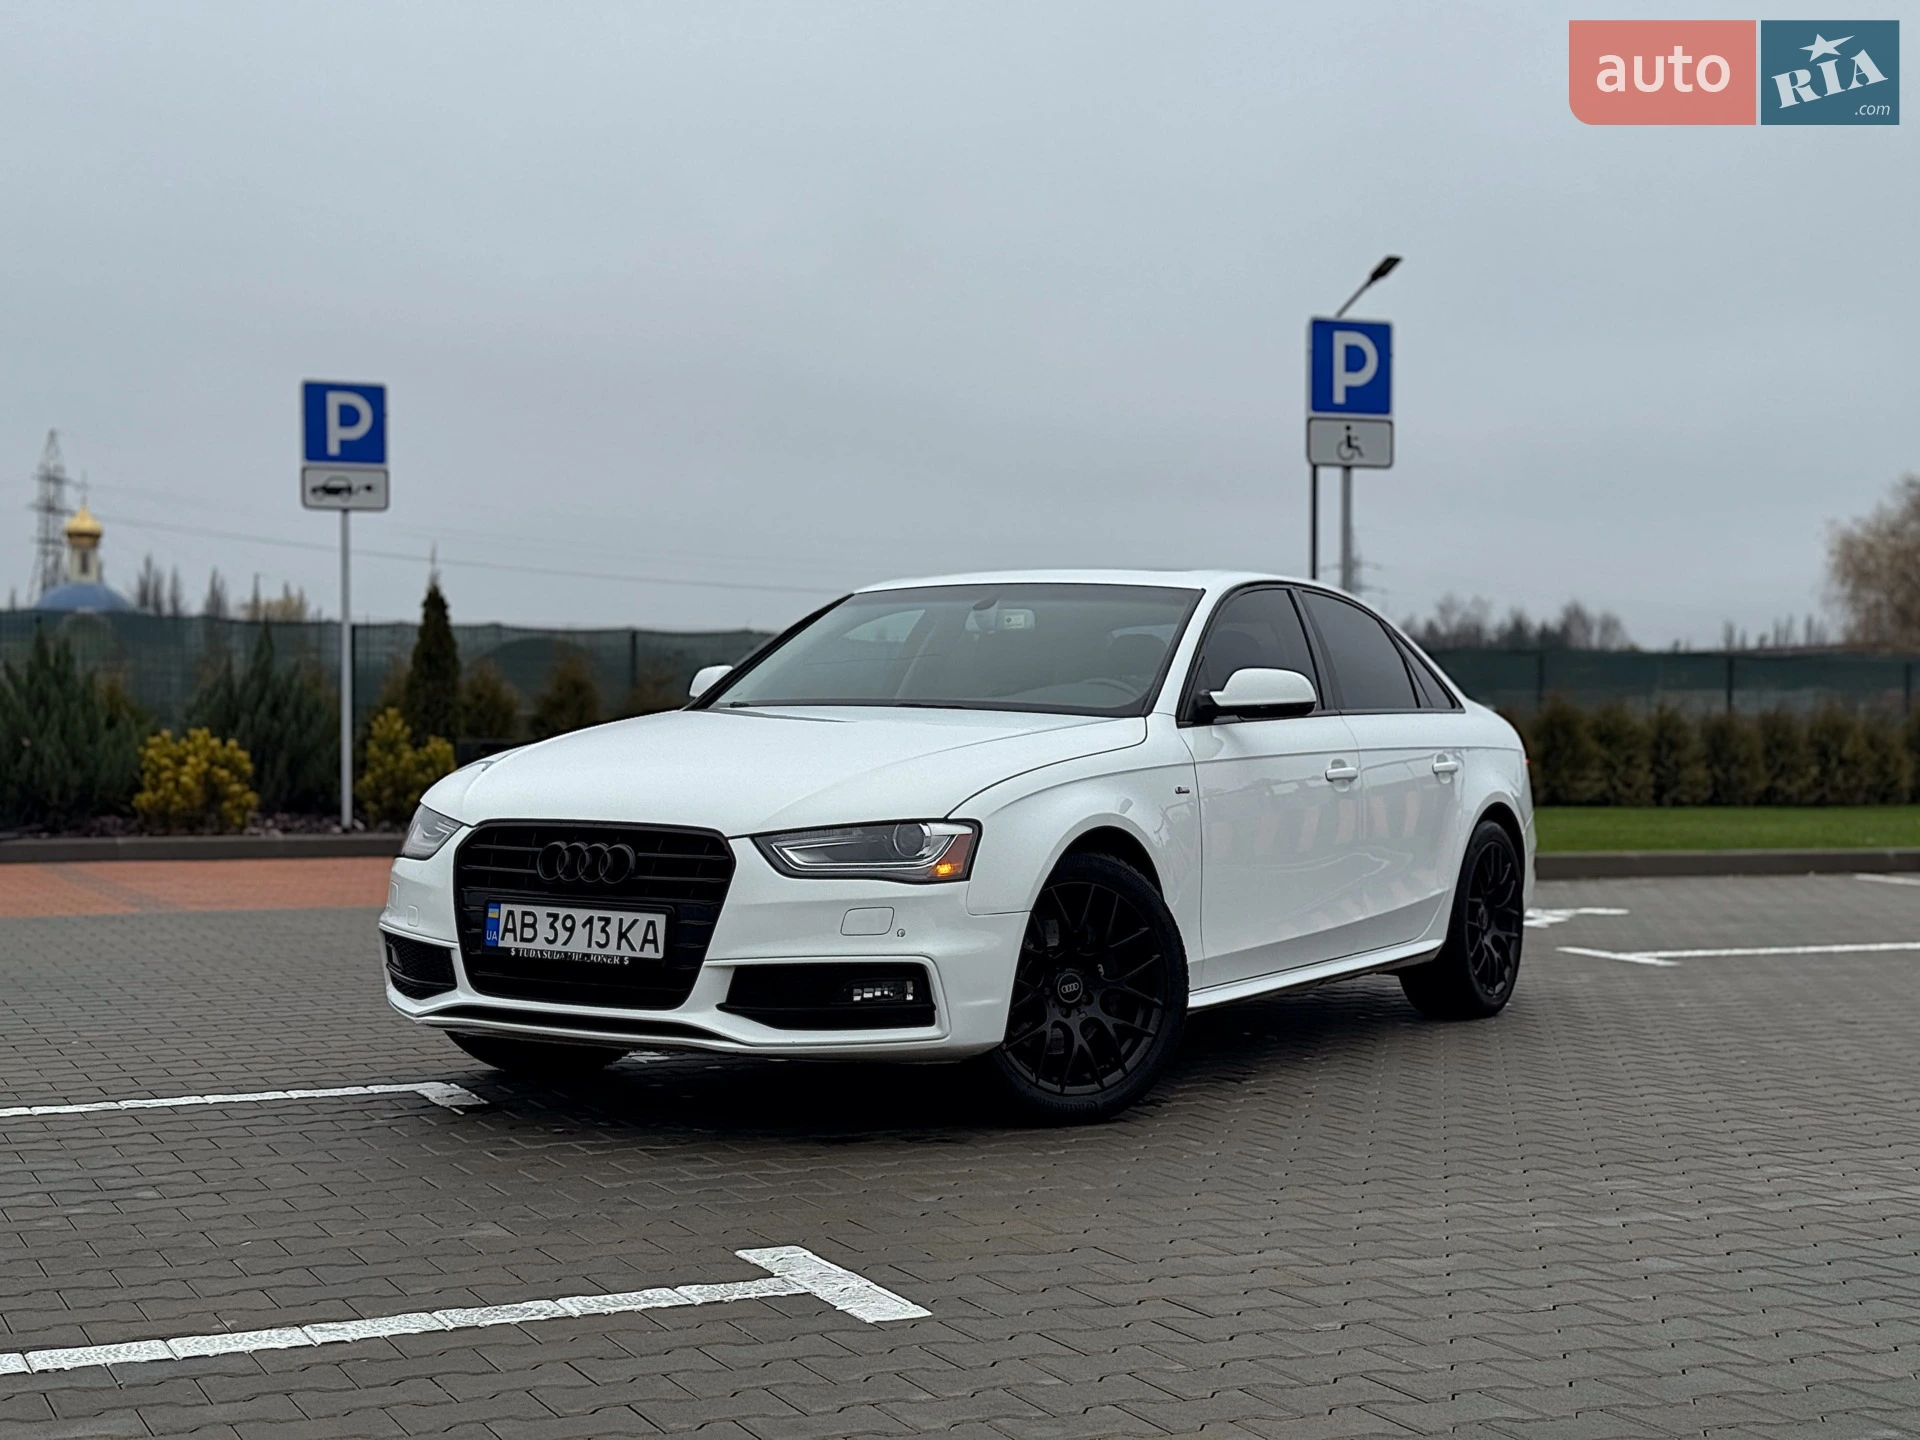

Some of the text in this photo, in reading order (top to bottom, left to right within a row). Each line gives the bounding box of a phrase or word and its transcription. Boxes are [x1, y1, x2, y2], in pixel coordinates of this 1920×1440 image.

[1332, 329, 1379, 405] P
[326, 390, 374, 456] P
[486, 930, 498, 941] UA
